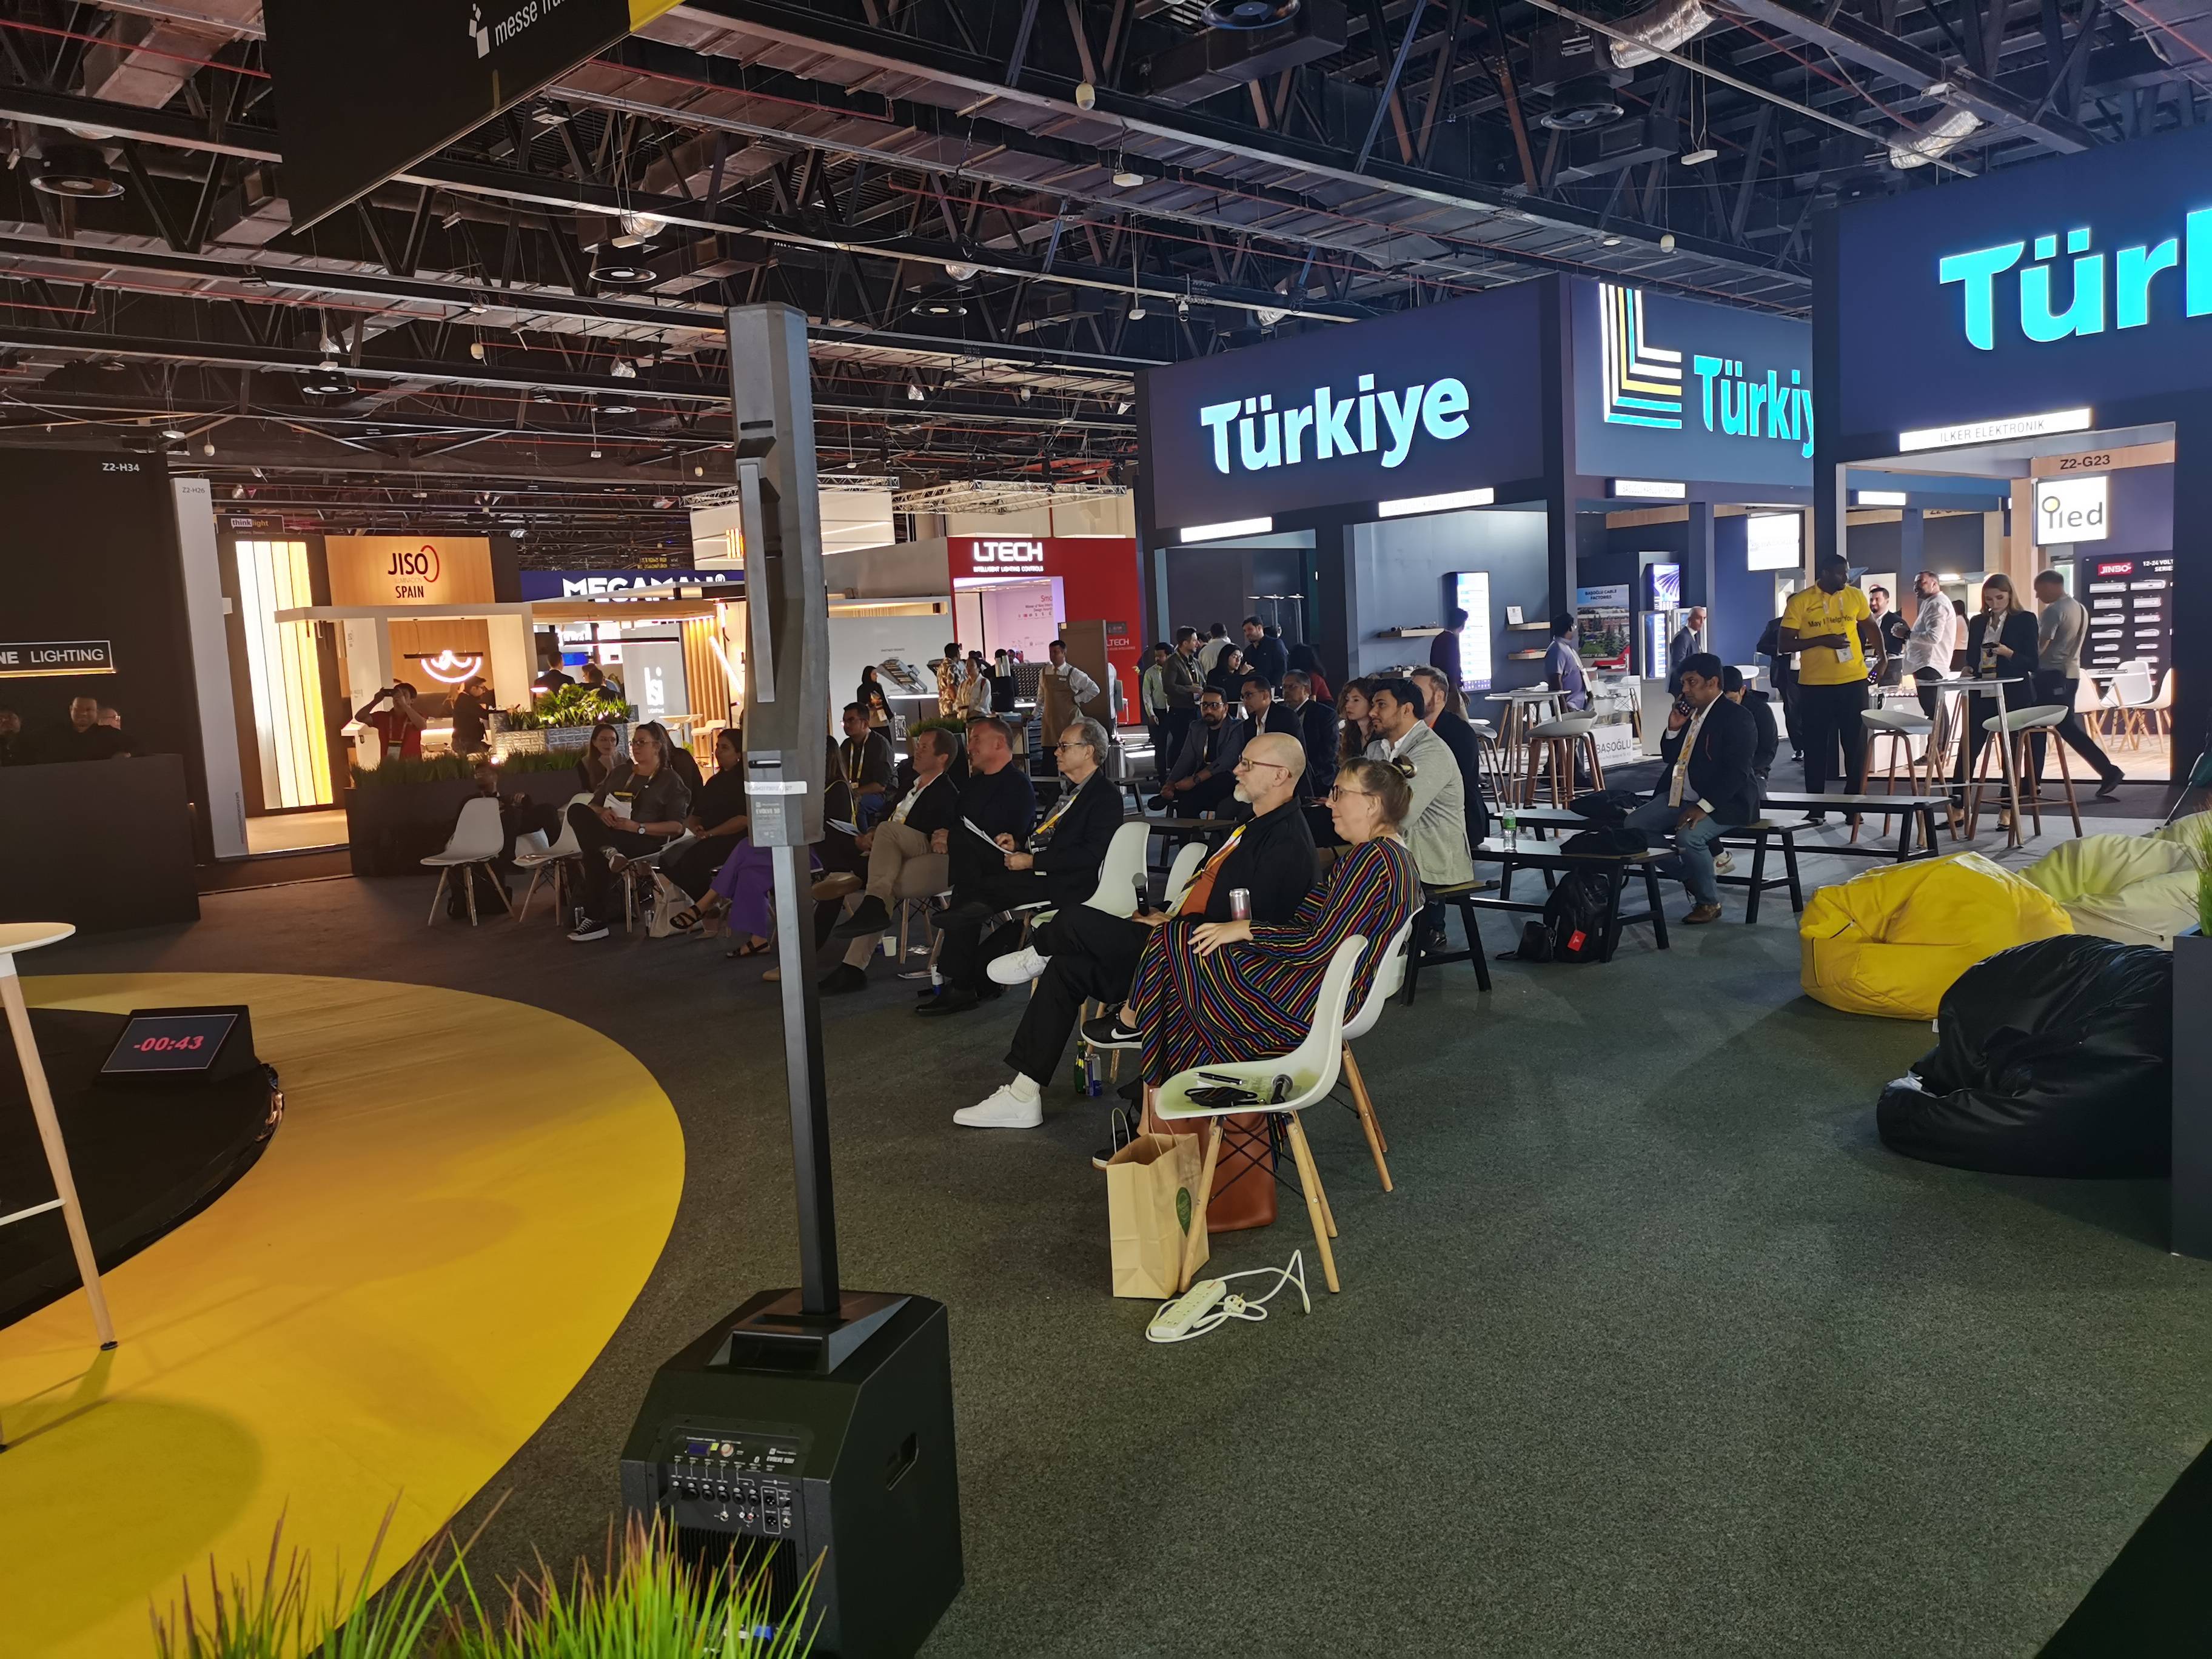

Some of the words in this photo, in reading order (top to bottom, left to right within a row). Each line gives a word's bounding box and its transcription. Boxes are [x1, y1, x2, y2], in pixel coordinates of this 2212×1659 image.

[495, 1, 537, 47] messe
[1201, 373, 1470, 474] Türkiye
[1976, 420, 2045, 438] ELEKTRONIK
[102, 463, 140, 472] Z2-H34
[2060, 455, 2111, 471] Z2-G23
[973, 541, 1043, 561] LTECH
[388, 552, 428, 575] JISO
[395, 585, 424, 598] SPAIN
[1107, 638, 1130, 646] LTECH
[30, 648, 104, 663] LIGHTING
[1596, 739, 1631, 754] BAŞOĞLU
[133, 1036, 204, 1051] -00:43
